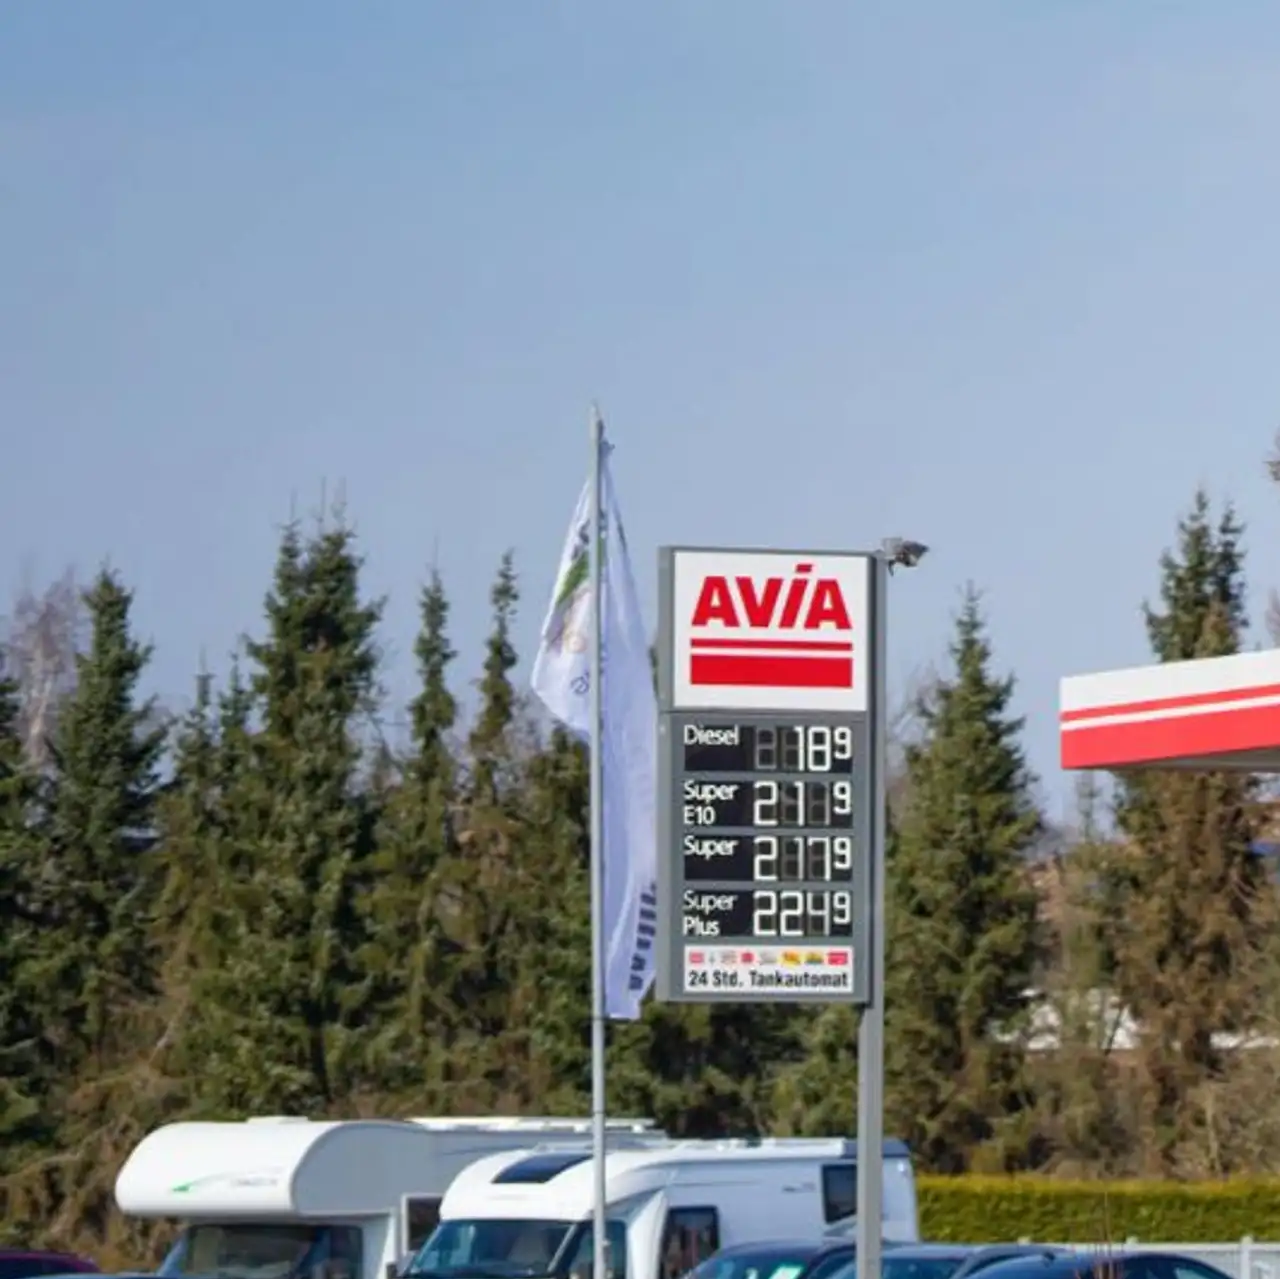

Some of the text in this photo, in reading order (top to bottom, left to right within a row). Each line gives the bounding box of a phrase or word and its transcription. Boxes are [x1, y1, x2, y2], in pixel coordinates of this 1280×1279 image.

[684, 725, 739, 745] Diesel
[683, 780, 738, 804] Super
[684, 806, 715, 824] E10
[683, 835, 851, 881] Super 2179
[683, 890, 851, 936] Super 2249
[683, 916, 720, 936] Plus
[688, 968, 848, 988] 24 Std. Tankautomat
